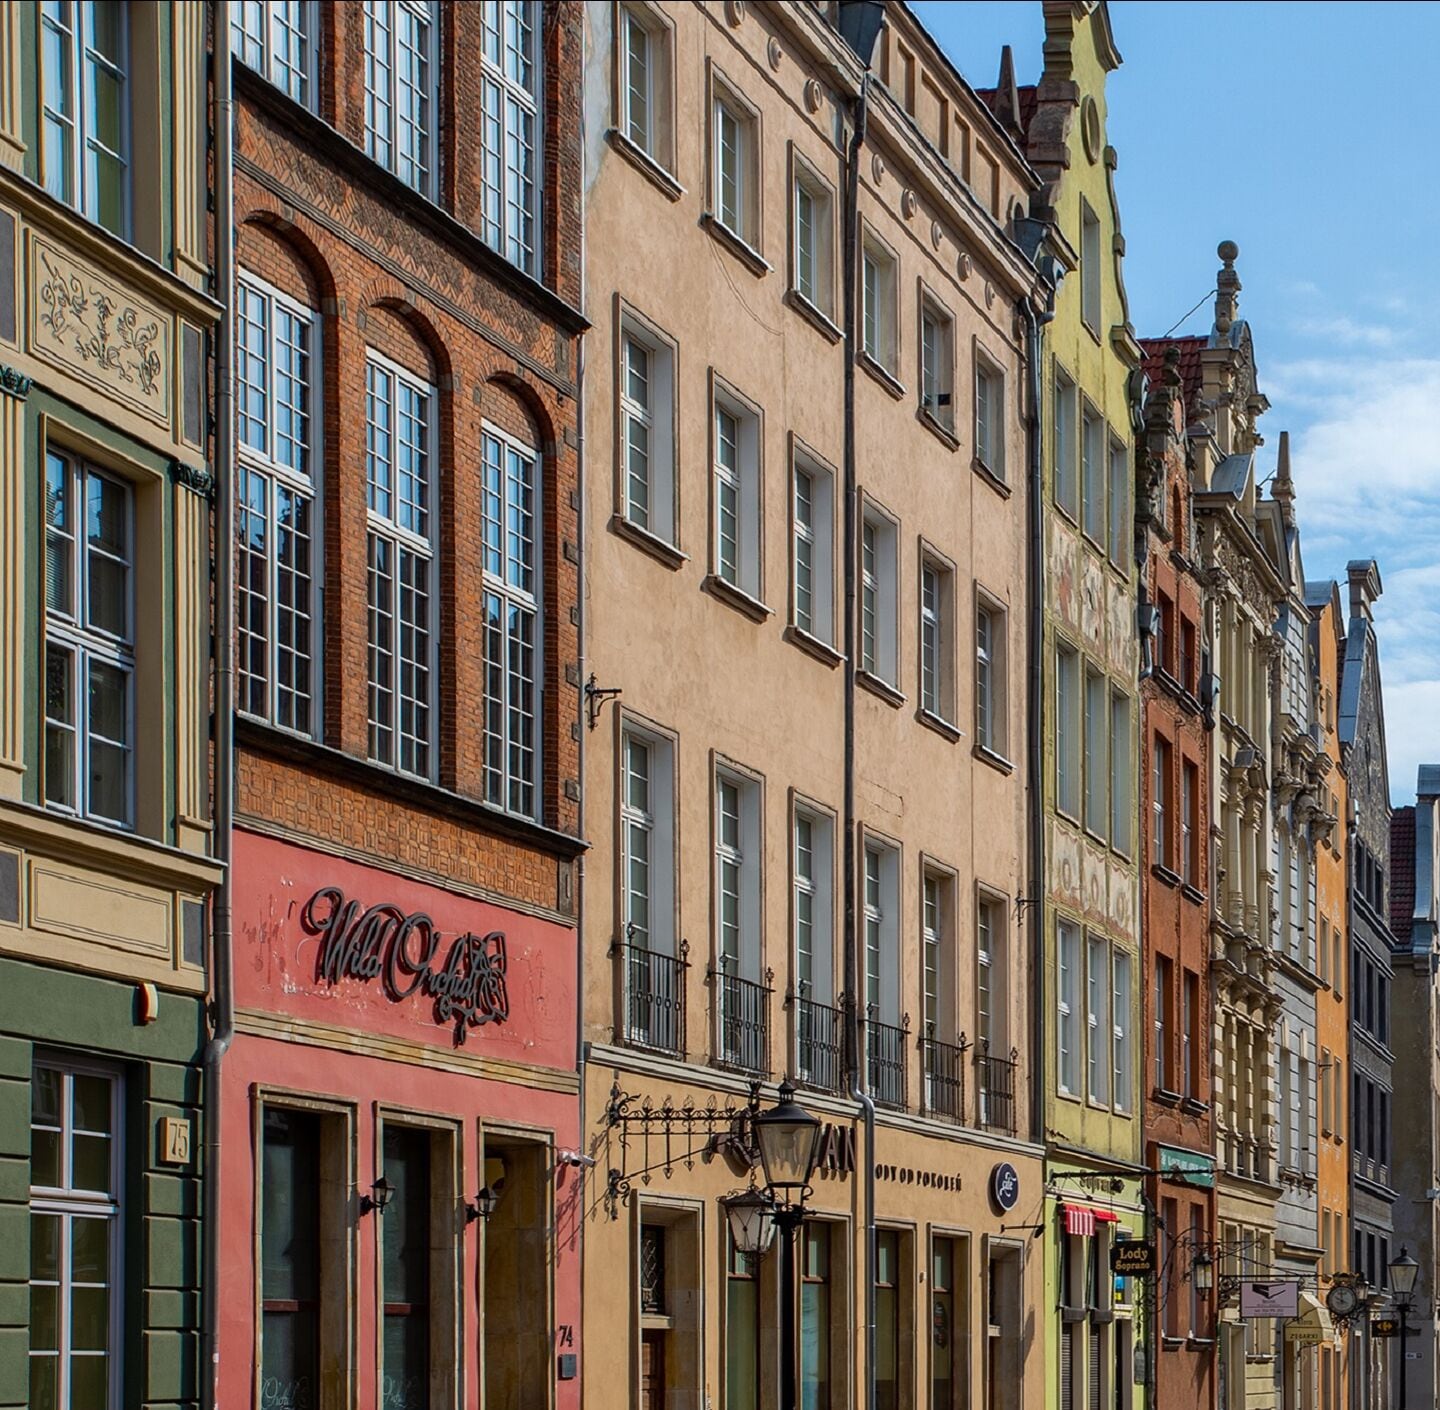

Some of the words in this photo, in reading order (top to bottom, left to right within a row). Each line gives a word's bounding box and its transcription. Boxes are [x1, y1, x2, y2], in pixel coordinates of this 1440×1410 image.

[308, 887, 398, 985] Wild
[169, 1122, 188, 1158] 75
[875, 1163, 897, 1182] ODY
[899, 1167, 914, 1184] OD
[916, 1170, 962, 1192] POKOLEŃ
[1079, 1169, 1116, 1195] Sopran
[1115, 1260, 1150, 1272] Soprano
[1119, 1248, 1149, 1261] Lody
[559, 1325, 573, 1347] 74
